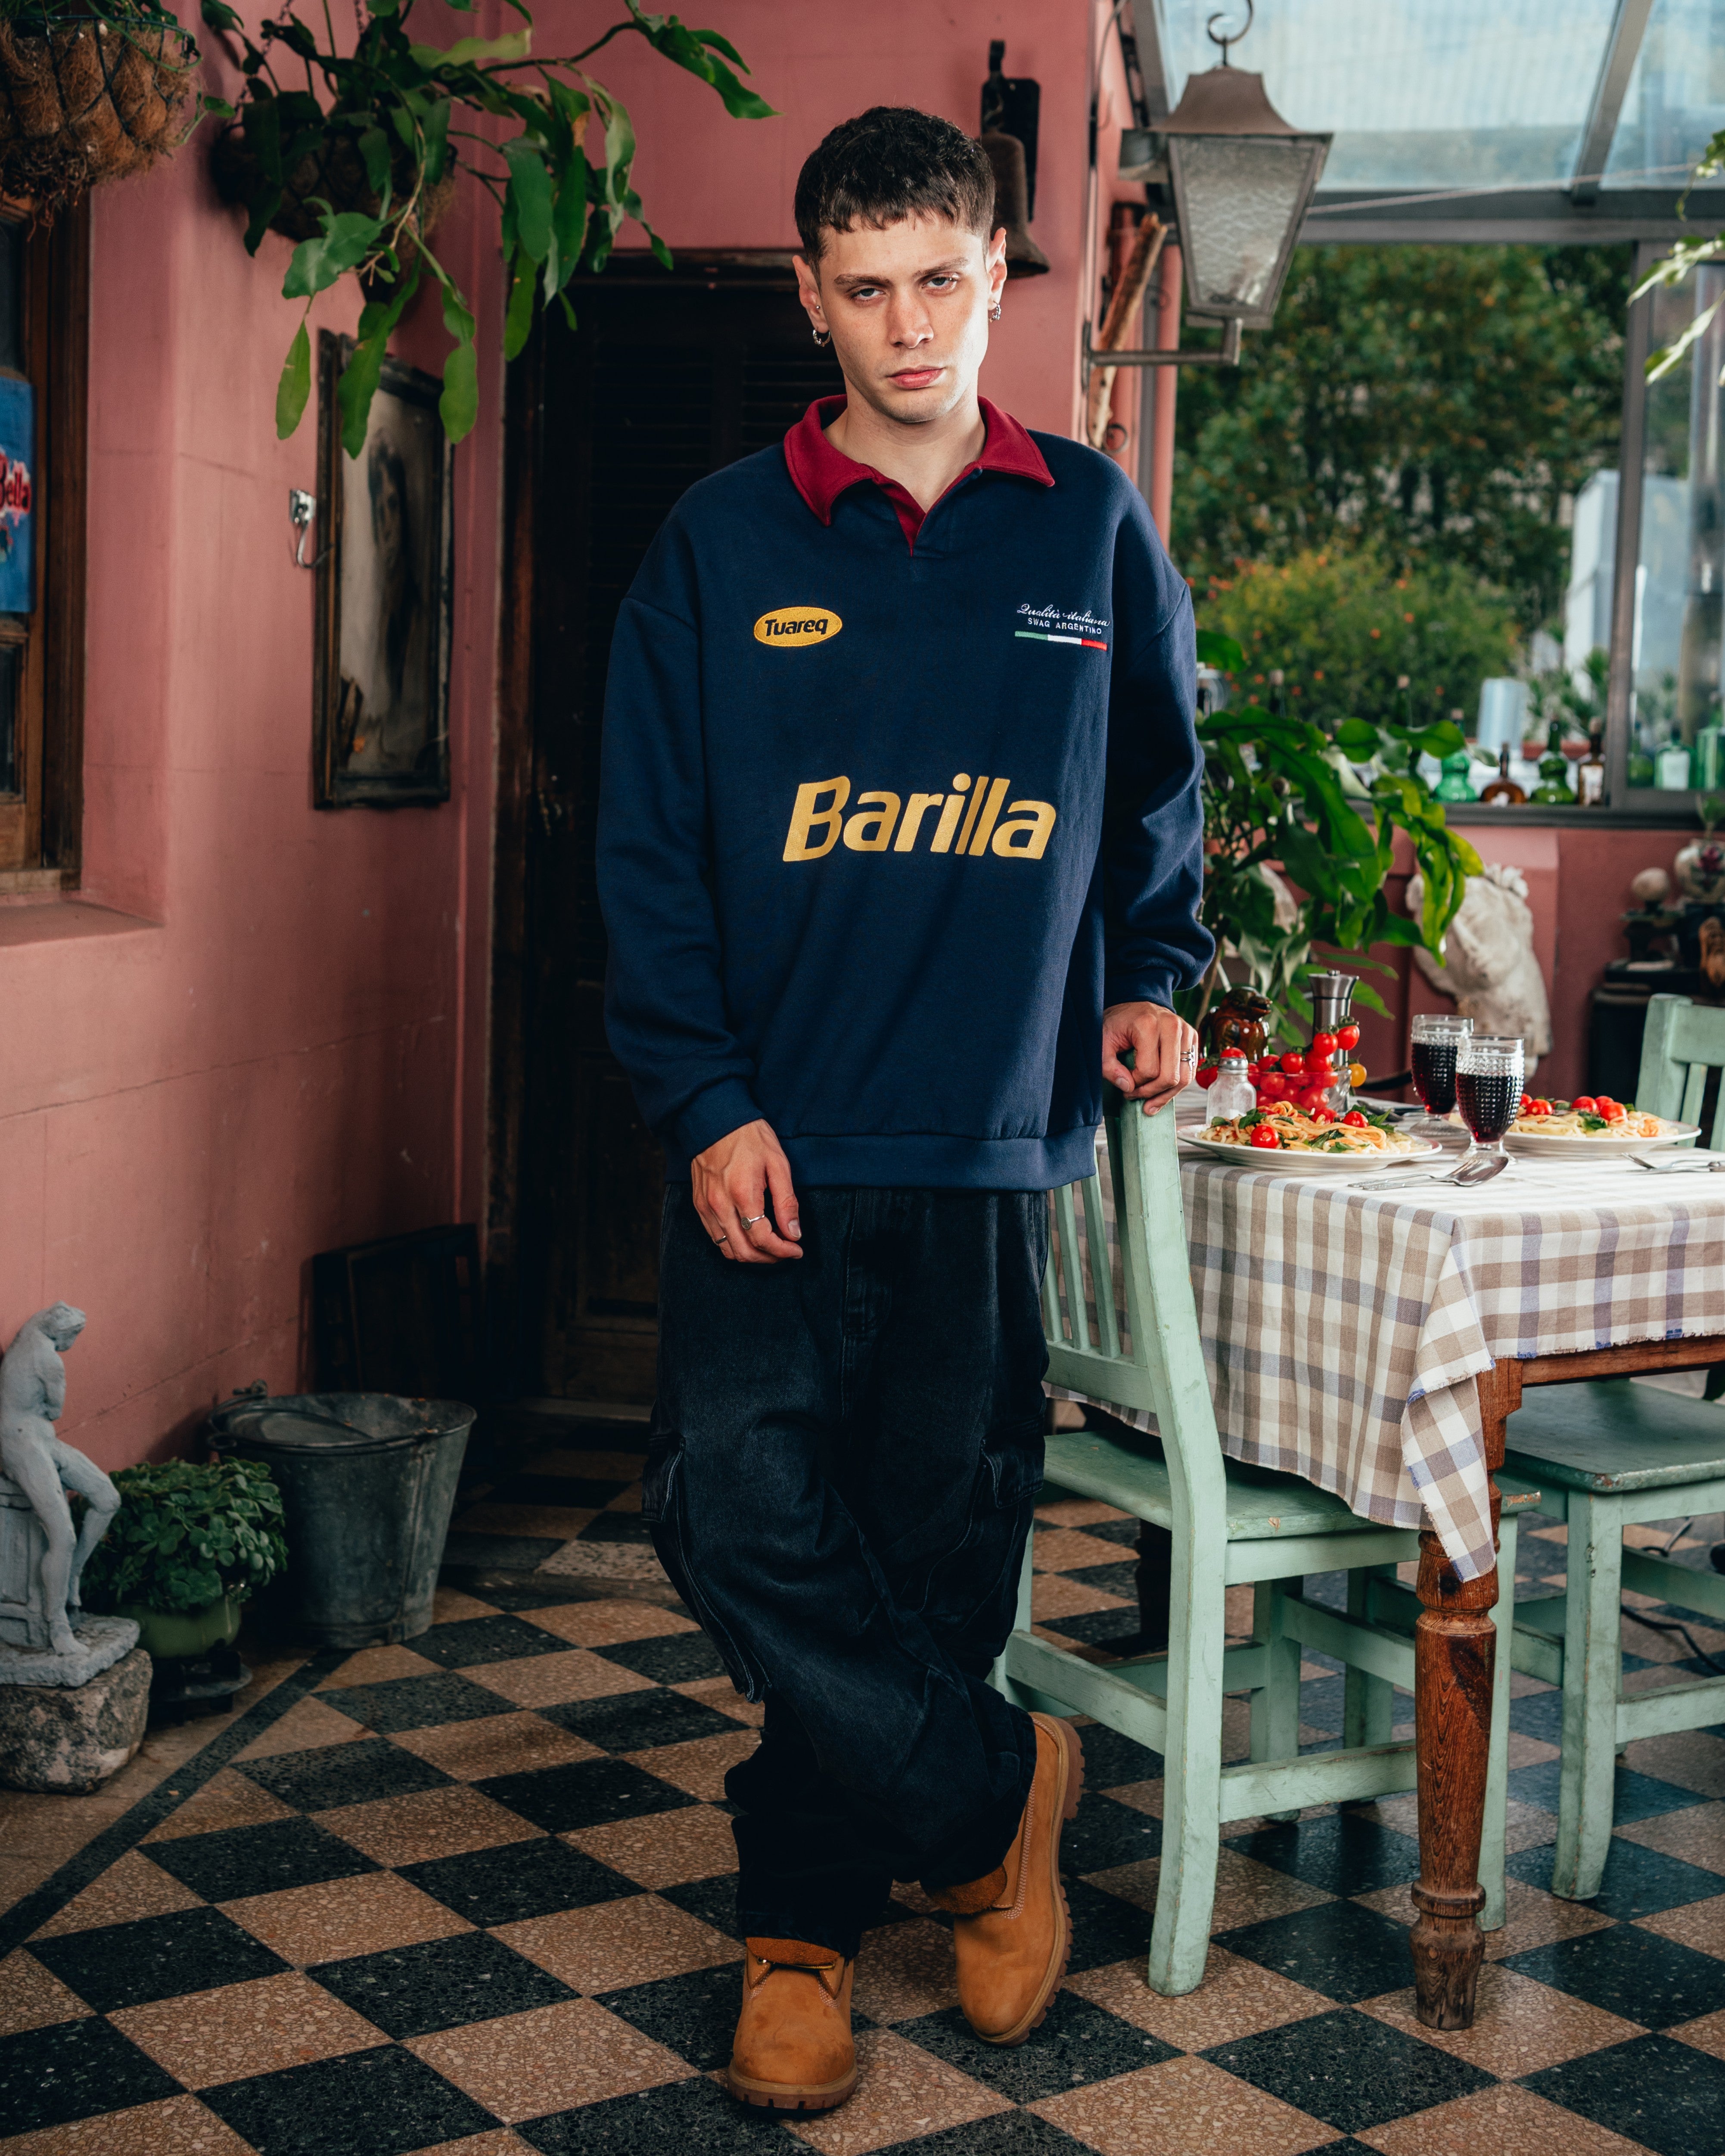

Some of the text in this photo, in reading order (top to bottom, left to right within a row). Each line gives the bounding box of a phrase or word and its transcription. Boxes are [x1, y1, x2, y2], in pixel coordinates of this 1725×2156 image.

[1028, 618, 1102, 634] SWAG ARGENTINO
[783, 773, 1056, 862] Barilla
